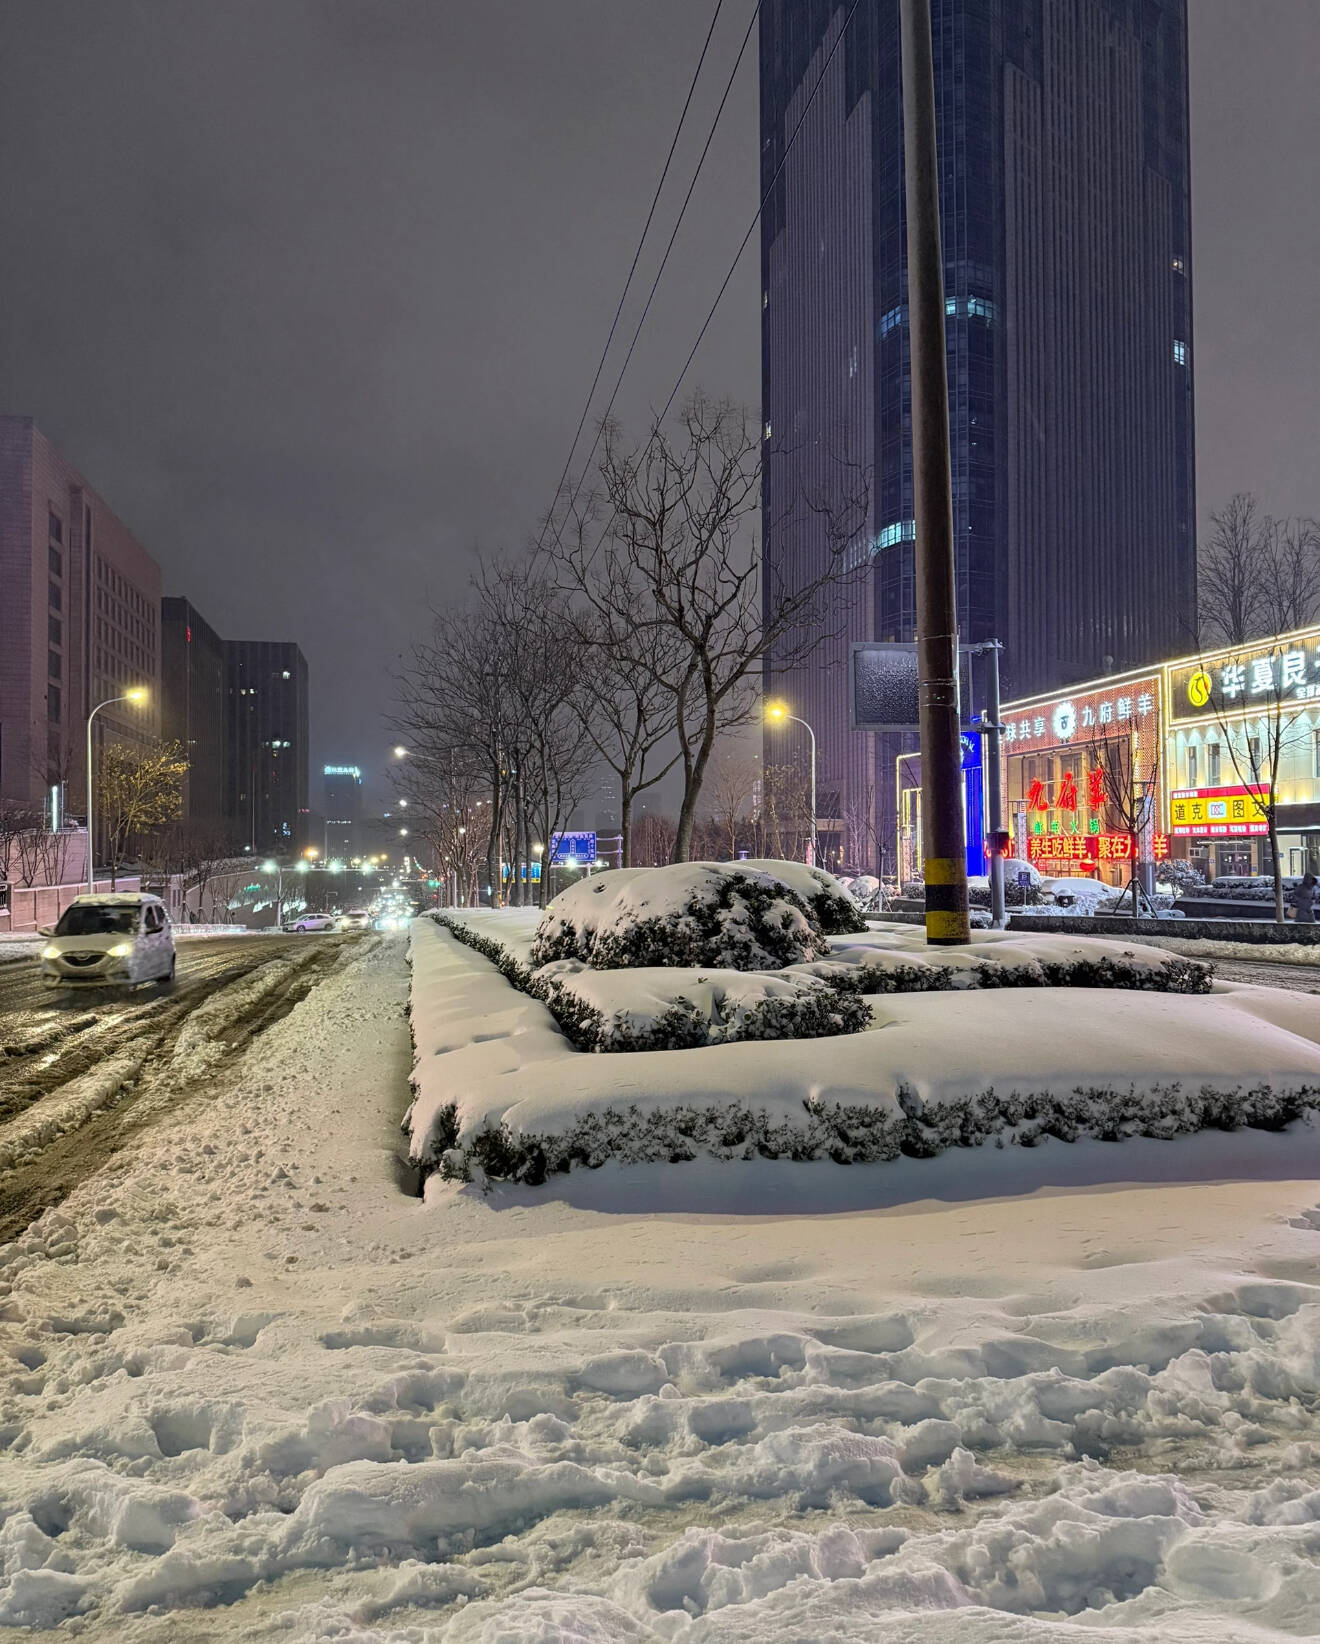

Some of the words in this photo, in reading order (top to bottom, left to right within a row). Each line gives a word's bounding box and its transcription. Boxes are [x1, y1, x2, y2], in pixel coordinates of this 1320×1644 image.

[1221, 648, 1320, 692] 华夏良
[999, 715, 1045, 744] 球共享
[1082, 692, 1154, 727] 九府鲜羊
[1175, 803, 1203, 820] 道克
